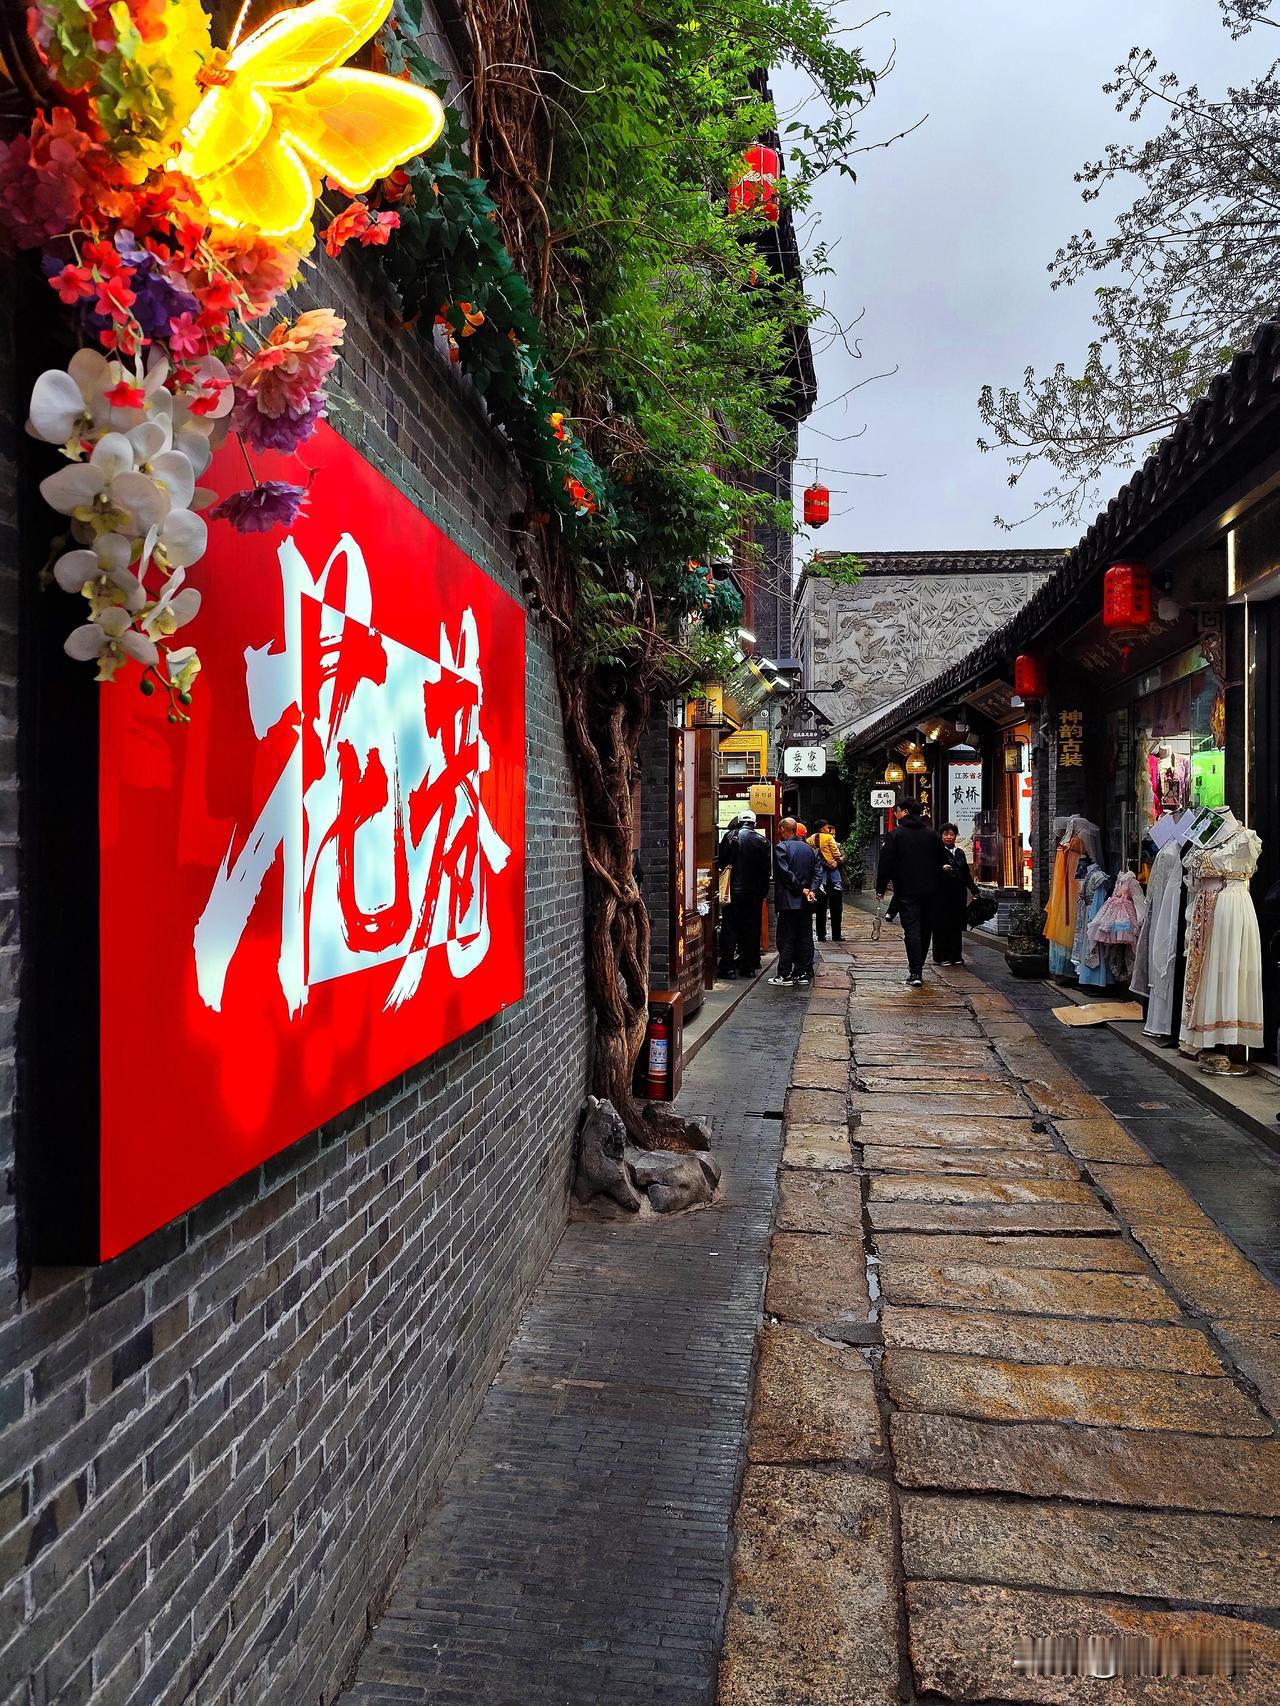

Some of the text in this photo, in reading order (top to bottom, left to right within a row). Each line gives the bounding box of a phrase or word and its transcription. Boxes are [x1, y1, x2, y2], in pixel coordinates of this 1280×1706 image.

[1058, 709, 1084, 767] 神韵古装
[193, 532, 511, 1021] 花巷
[951, 784, 980, 804] 黄桥
